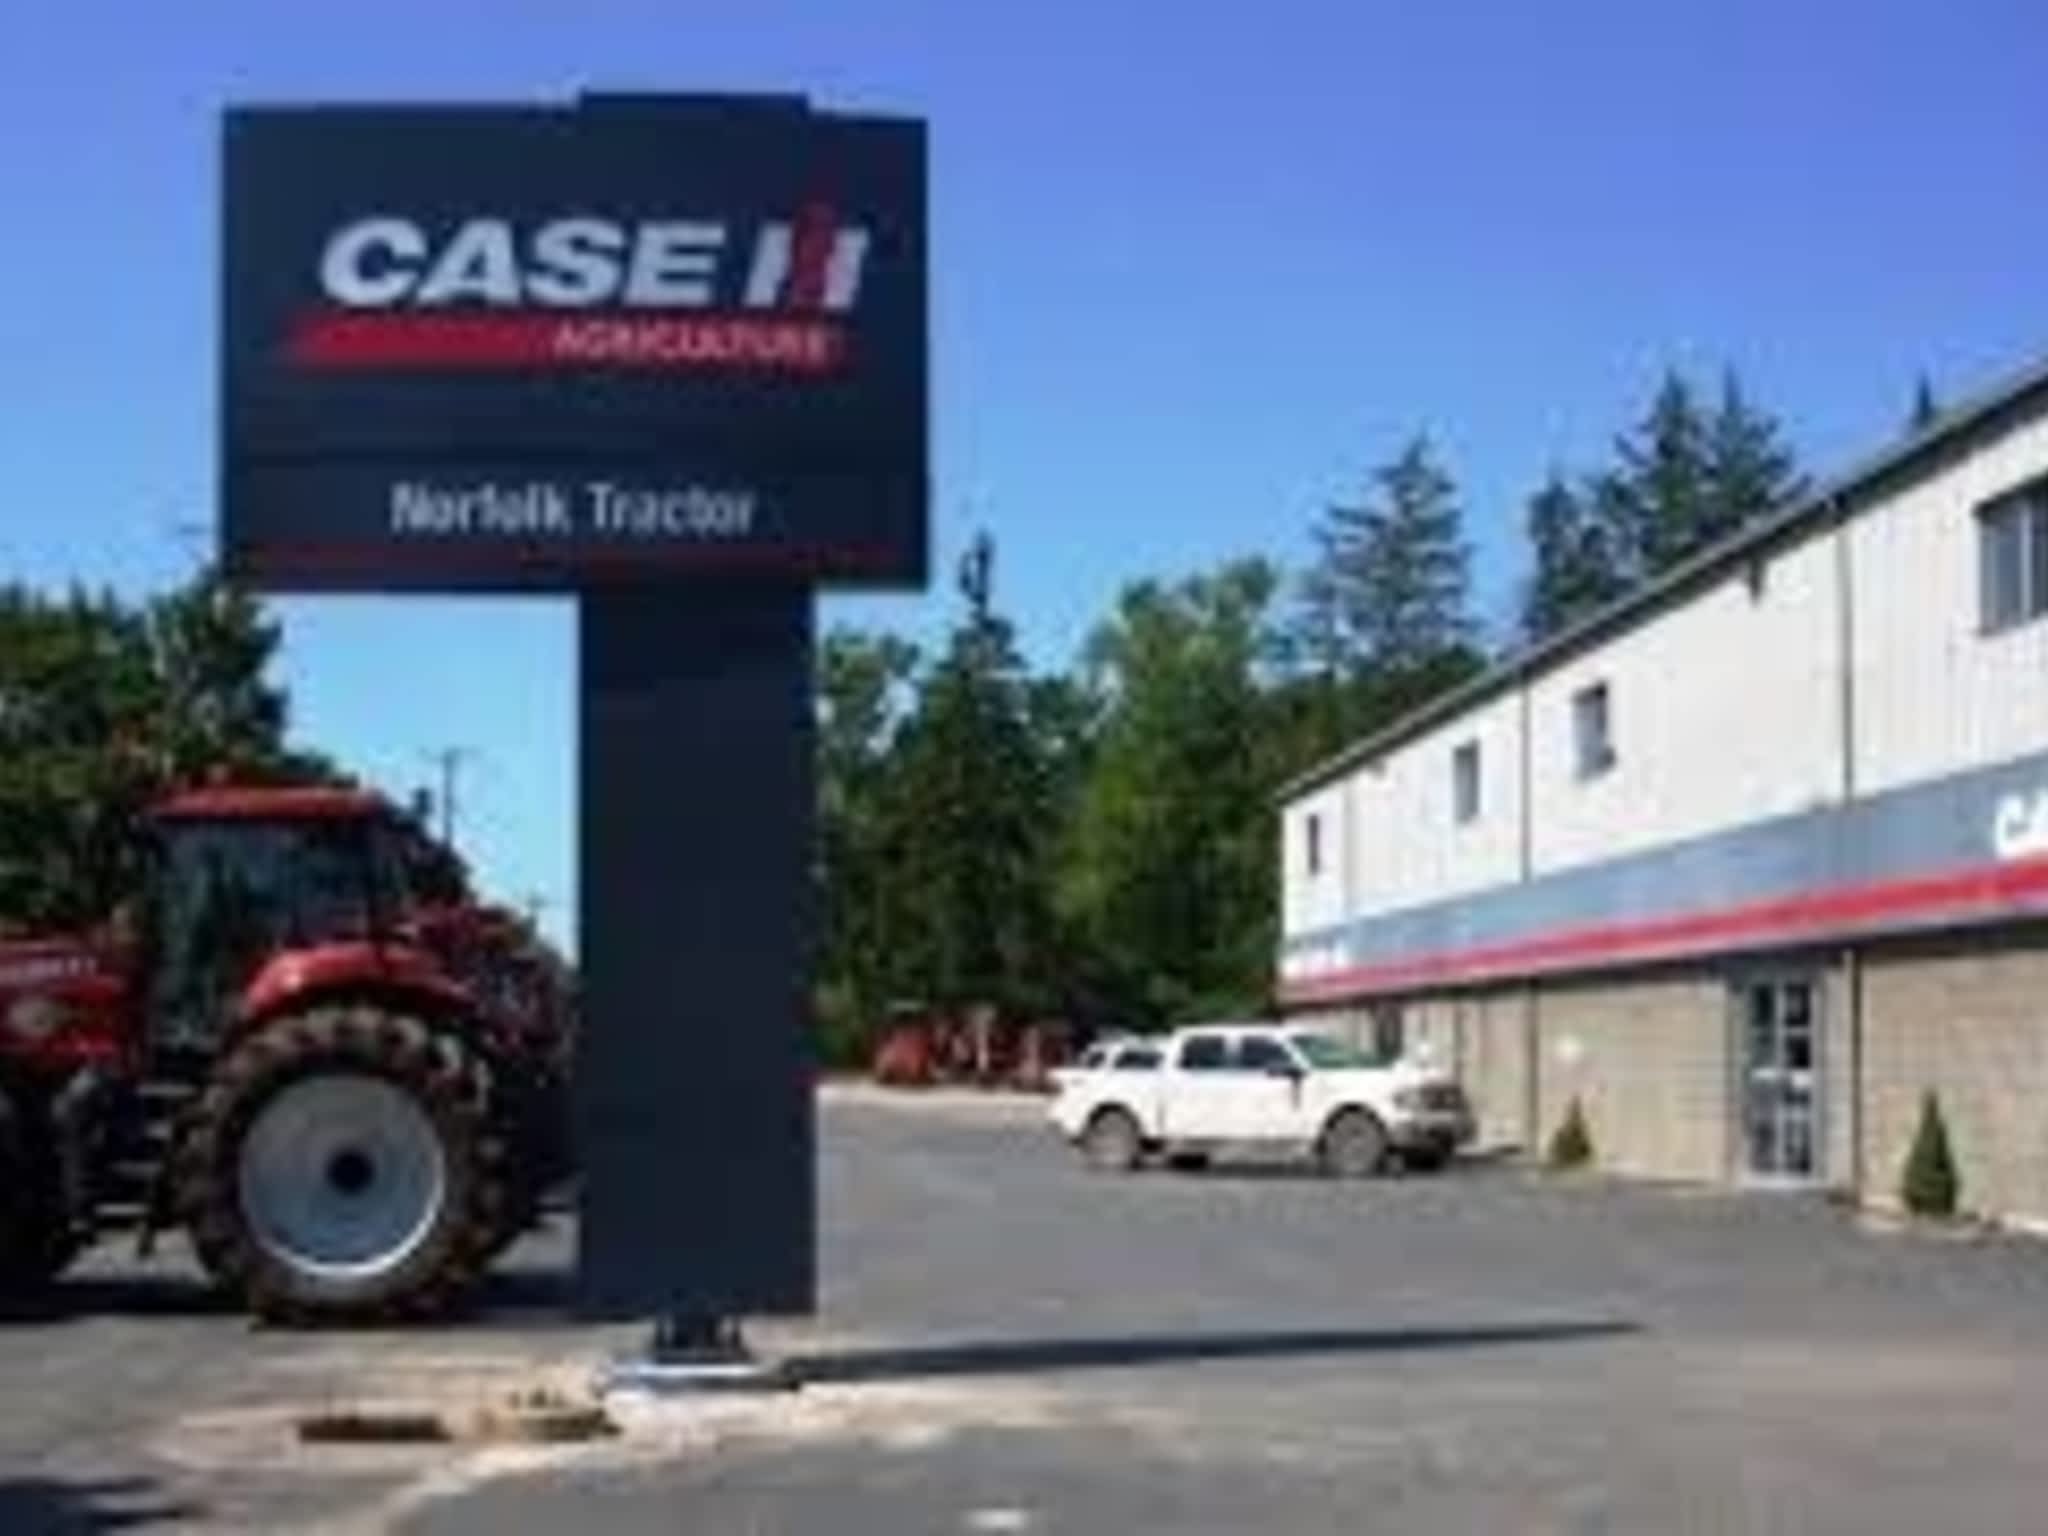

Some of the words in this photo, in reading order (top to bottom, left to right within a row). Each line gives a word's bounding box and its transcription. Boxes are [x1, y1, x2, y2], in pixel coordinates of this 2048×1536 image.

[319, 217, 726, 308] CASE
[552, 325, 830, 364] AGRICULTURE
[390, 481, 572, 536] Norfolk
[587, 482, 757, 536] Tractor
